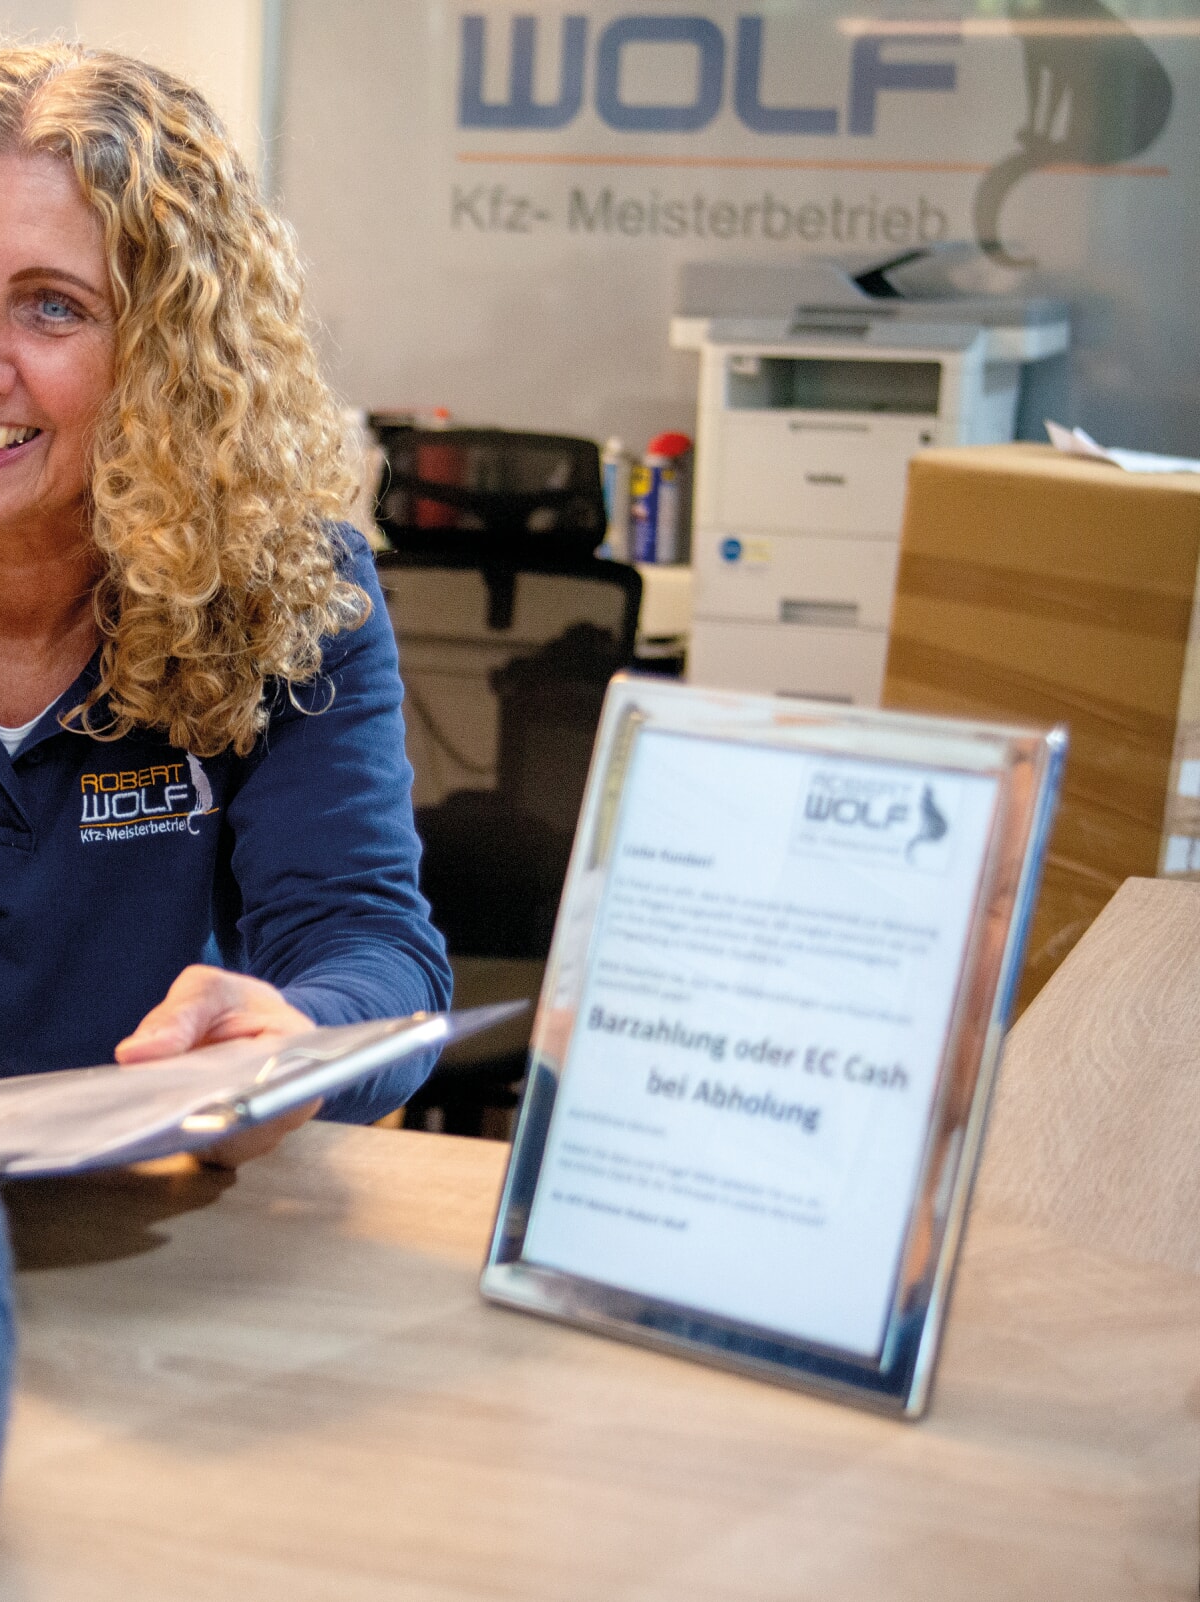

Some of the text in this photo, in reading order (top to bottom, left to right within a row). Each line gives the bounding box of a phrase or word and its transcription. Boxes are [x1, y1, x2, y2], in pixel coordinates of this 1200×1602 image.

[458, 16, 962, 136] WOLF
[449, 183, 950, 243] Kfz- Meisterbetrieb
[80, 763, 184, 794] ROBERT
[80, 784, 188, 823] WOLF
[804, 793, 909, 829] WOLF
[588, 1004, 910, 1092] Barzahlung oder EC Cash
[646, 1067, 687, 1098] bei
[691, 1080, 820, 1135] Abholung
